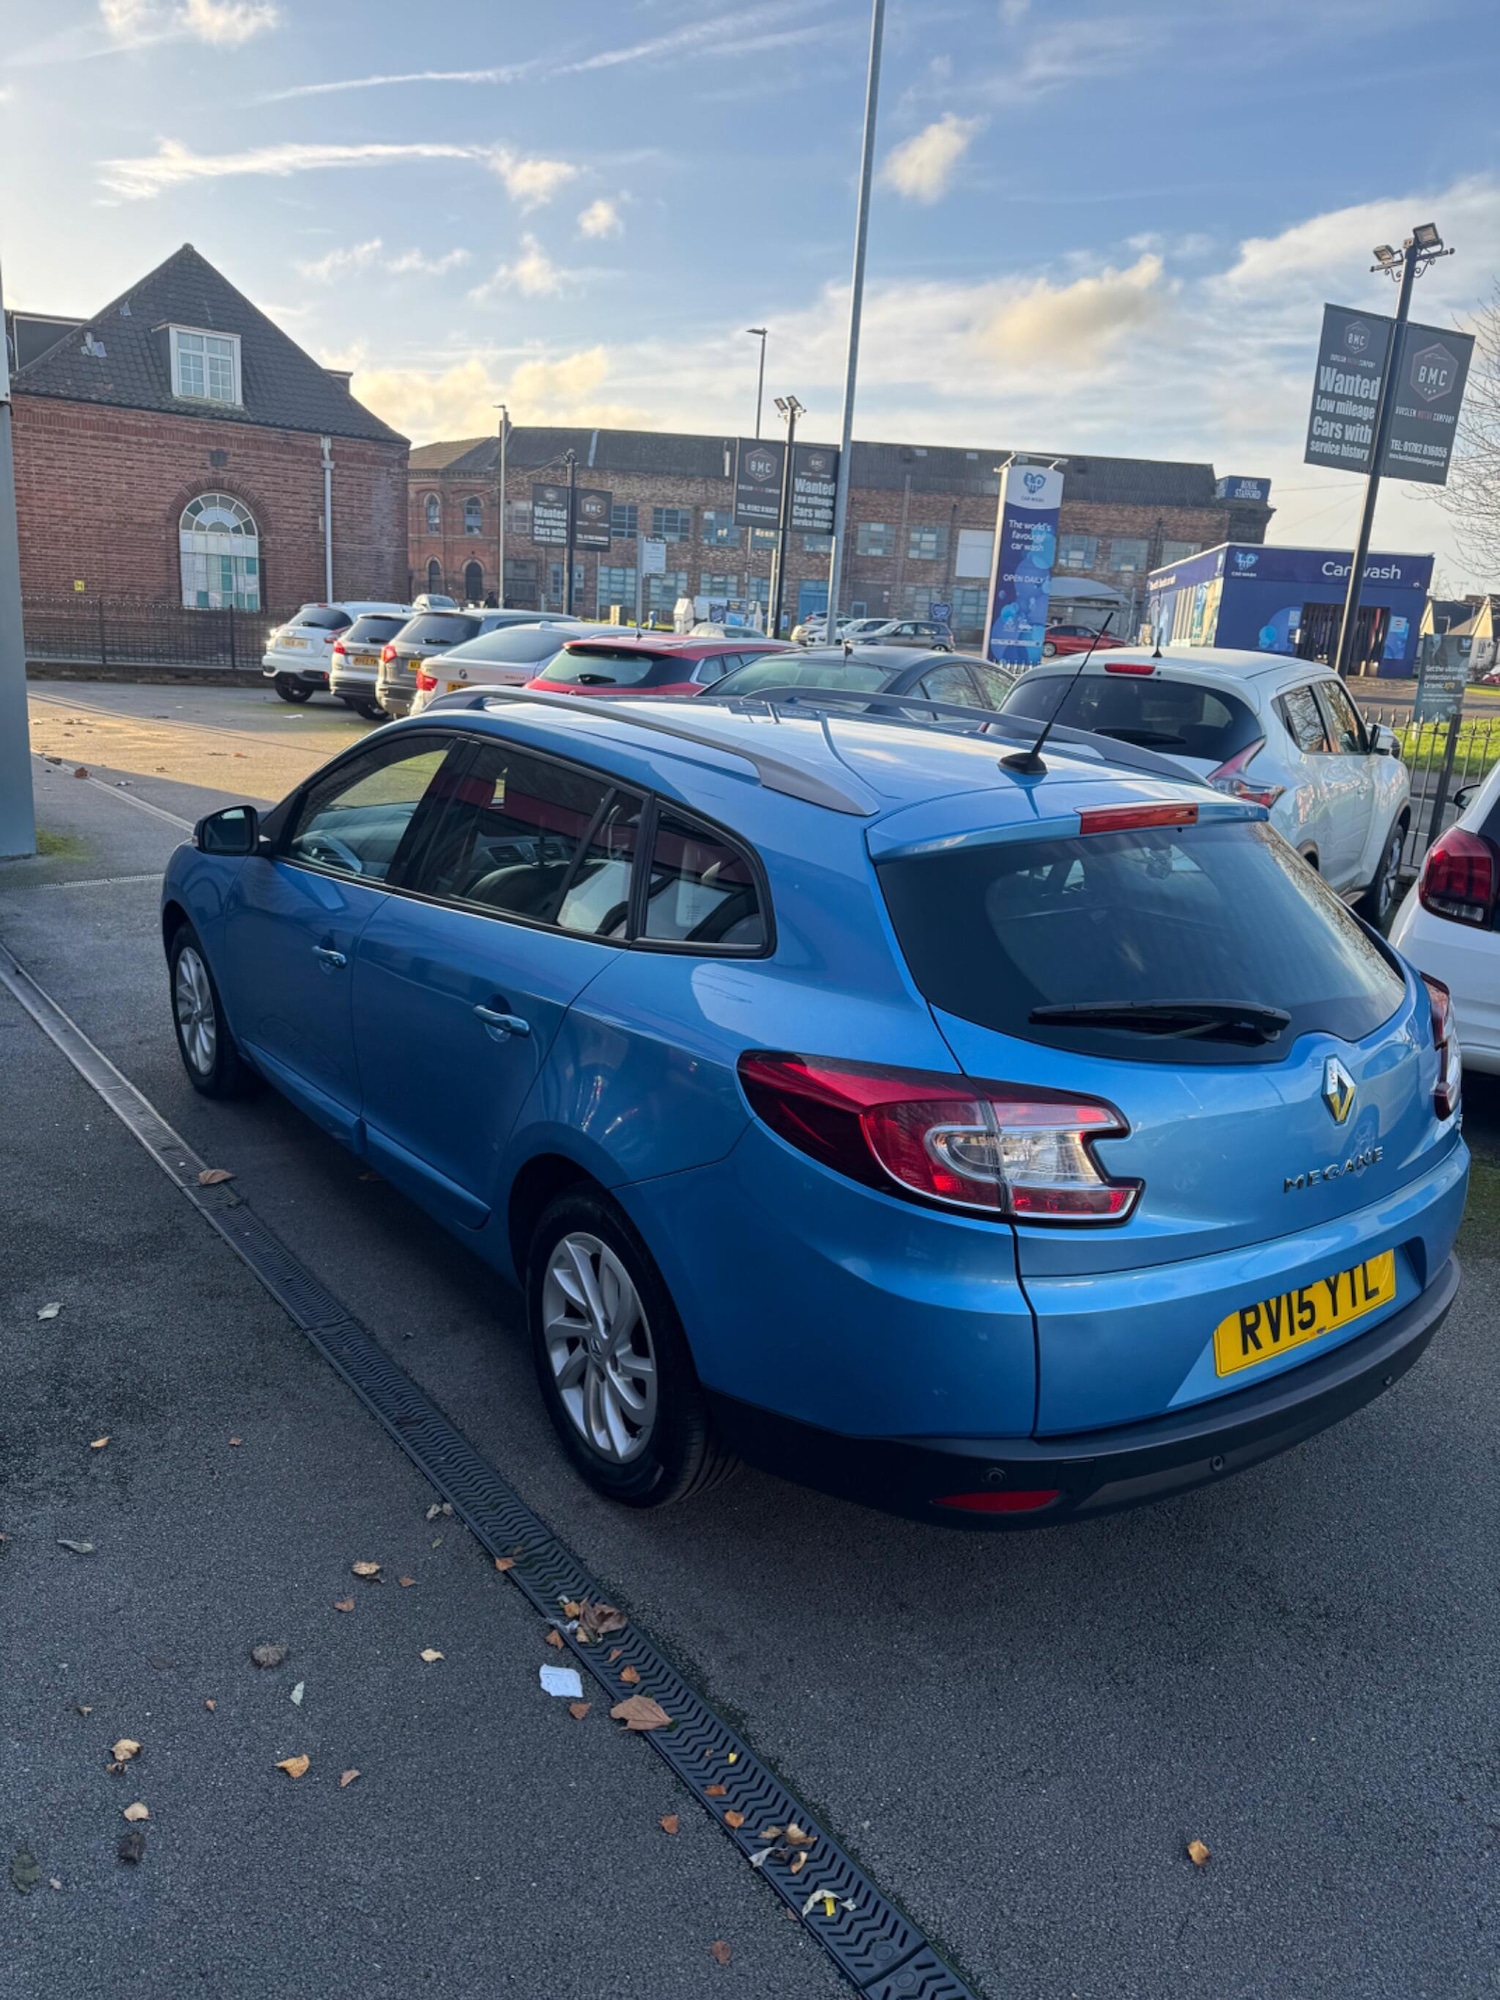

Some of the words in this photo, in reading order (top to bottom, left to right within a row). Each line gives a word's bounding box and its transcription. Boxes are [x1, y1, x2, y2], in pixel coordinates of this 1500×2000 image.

[1348, 333, 1365, 346] BMC
[1319, 365, 1381, 400] Wanted
[1418, 365, 1448, 387] BMC
[1315, 394, 1336, 413] Low
[1336, 400, 1375, 421] mileage
[1312, 415, 1343, 439] Cars
[1344, 423, 1373, 445] with
[1310, 440, 1341, 456] service
[1341, 443, 1370, 462] history
[750, 460, 772, 473] BMC
[794, 477, 836, 496] Wanted
[793, 505, 814, 518] Cars
[1009, 519, 1023, 529] The
[1024, 543, 1045, 552] wash
[1003, 573, 1023, 582] OPEN
[1024, 575, 1044, 584] DAILY
[1283, 1146, 1384, 1194] MEGANE
[1239, 1284, 1316, 1356] RV15
[1324, 1262, 1380, 1317] YTL
